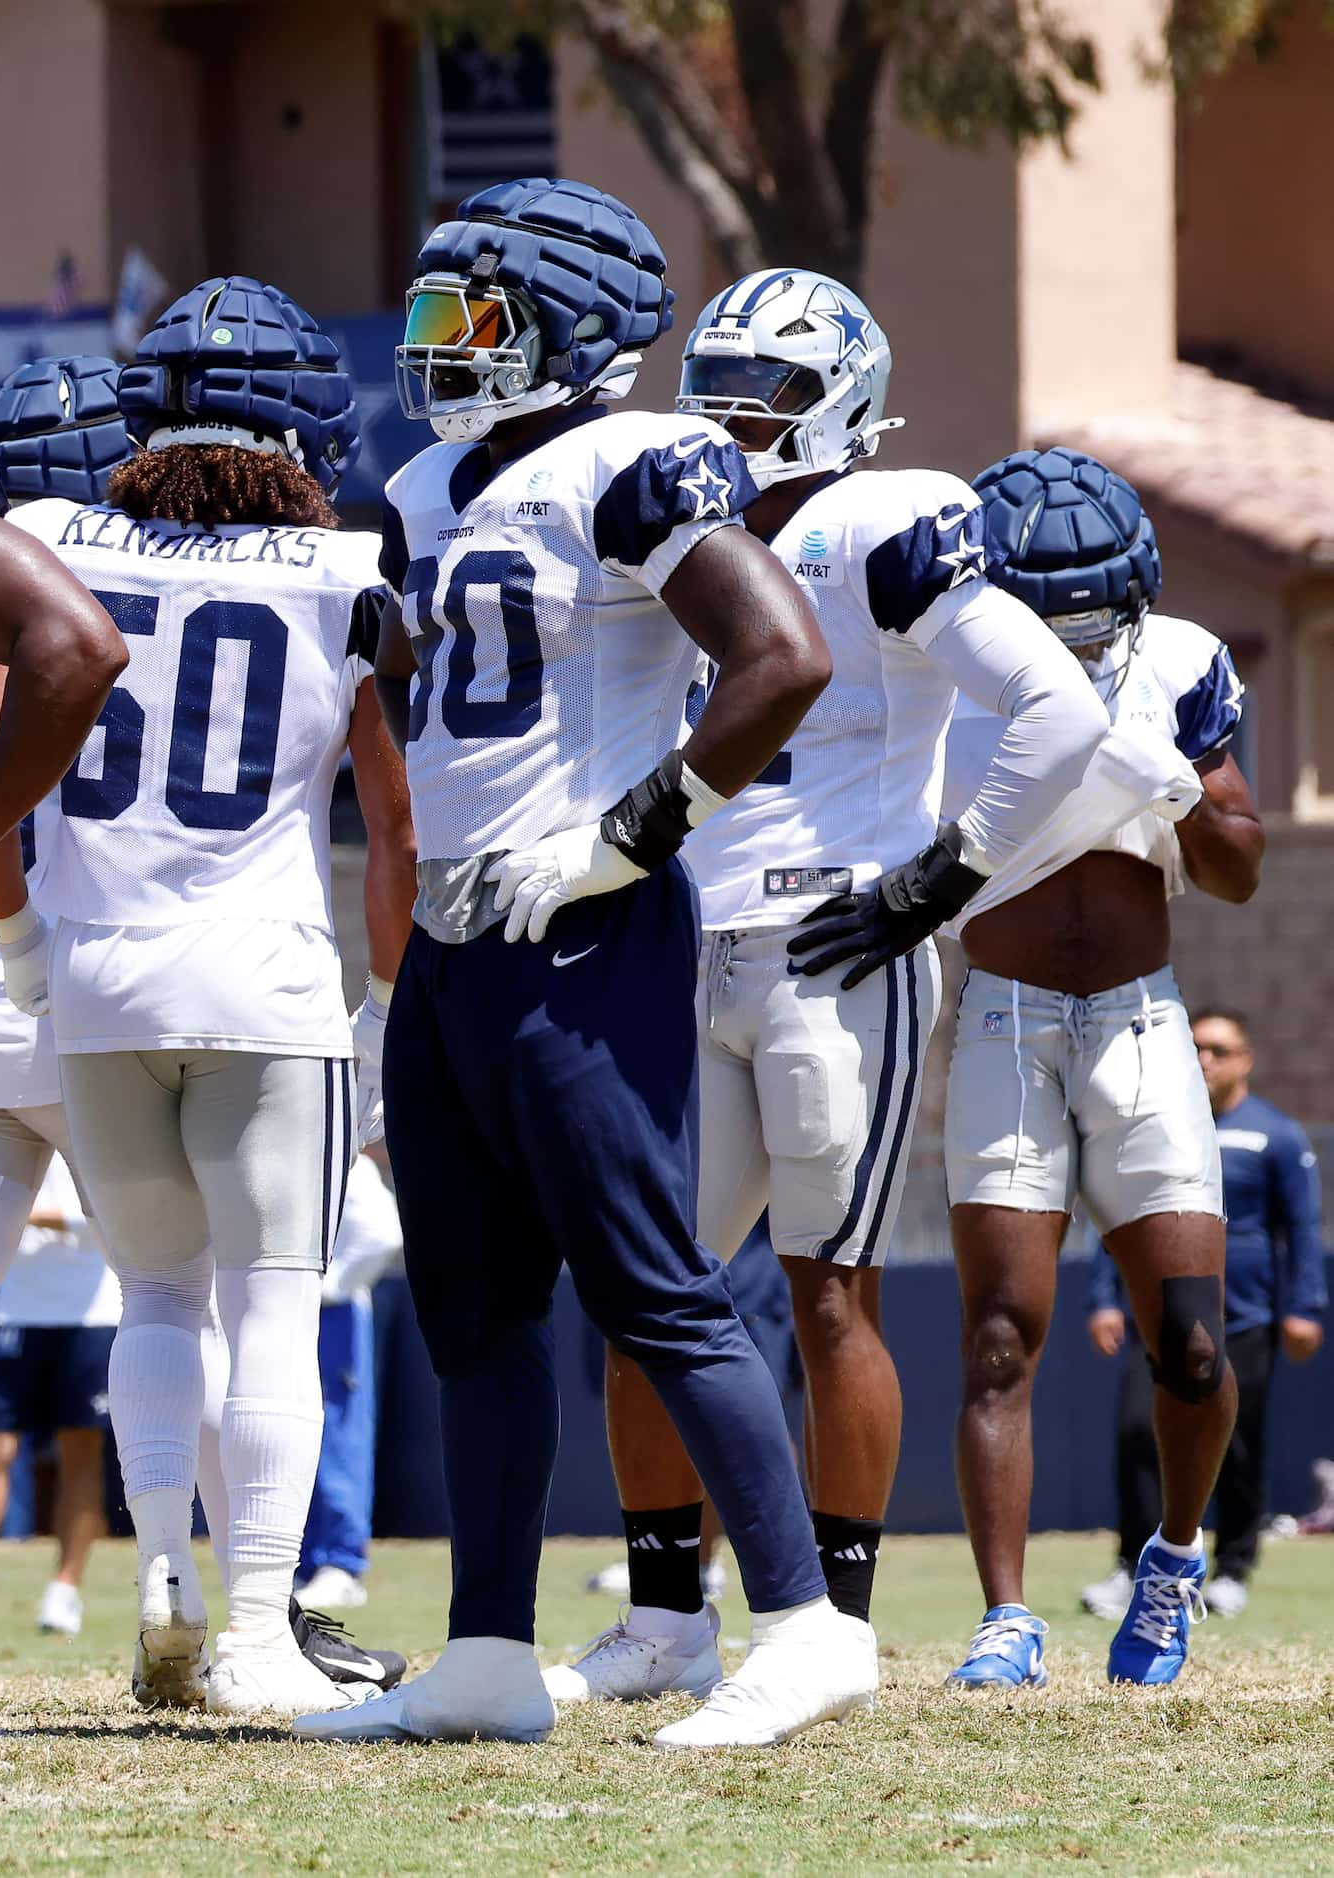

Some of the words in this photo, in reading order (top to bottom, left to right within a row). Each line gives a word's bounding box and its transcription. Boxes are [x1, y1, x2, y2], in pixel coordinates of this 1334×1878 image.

[704, 331, 742, 340] COWBOYS
[516, 502, 550, 517] AT&T
[57, 509, 326, 568] KENDRICKS
[437, 526, 475, 542] COWBOYS
[794, 563, 831, 578] AT&T
